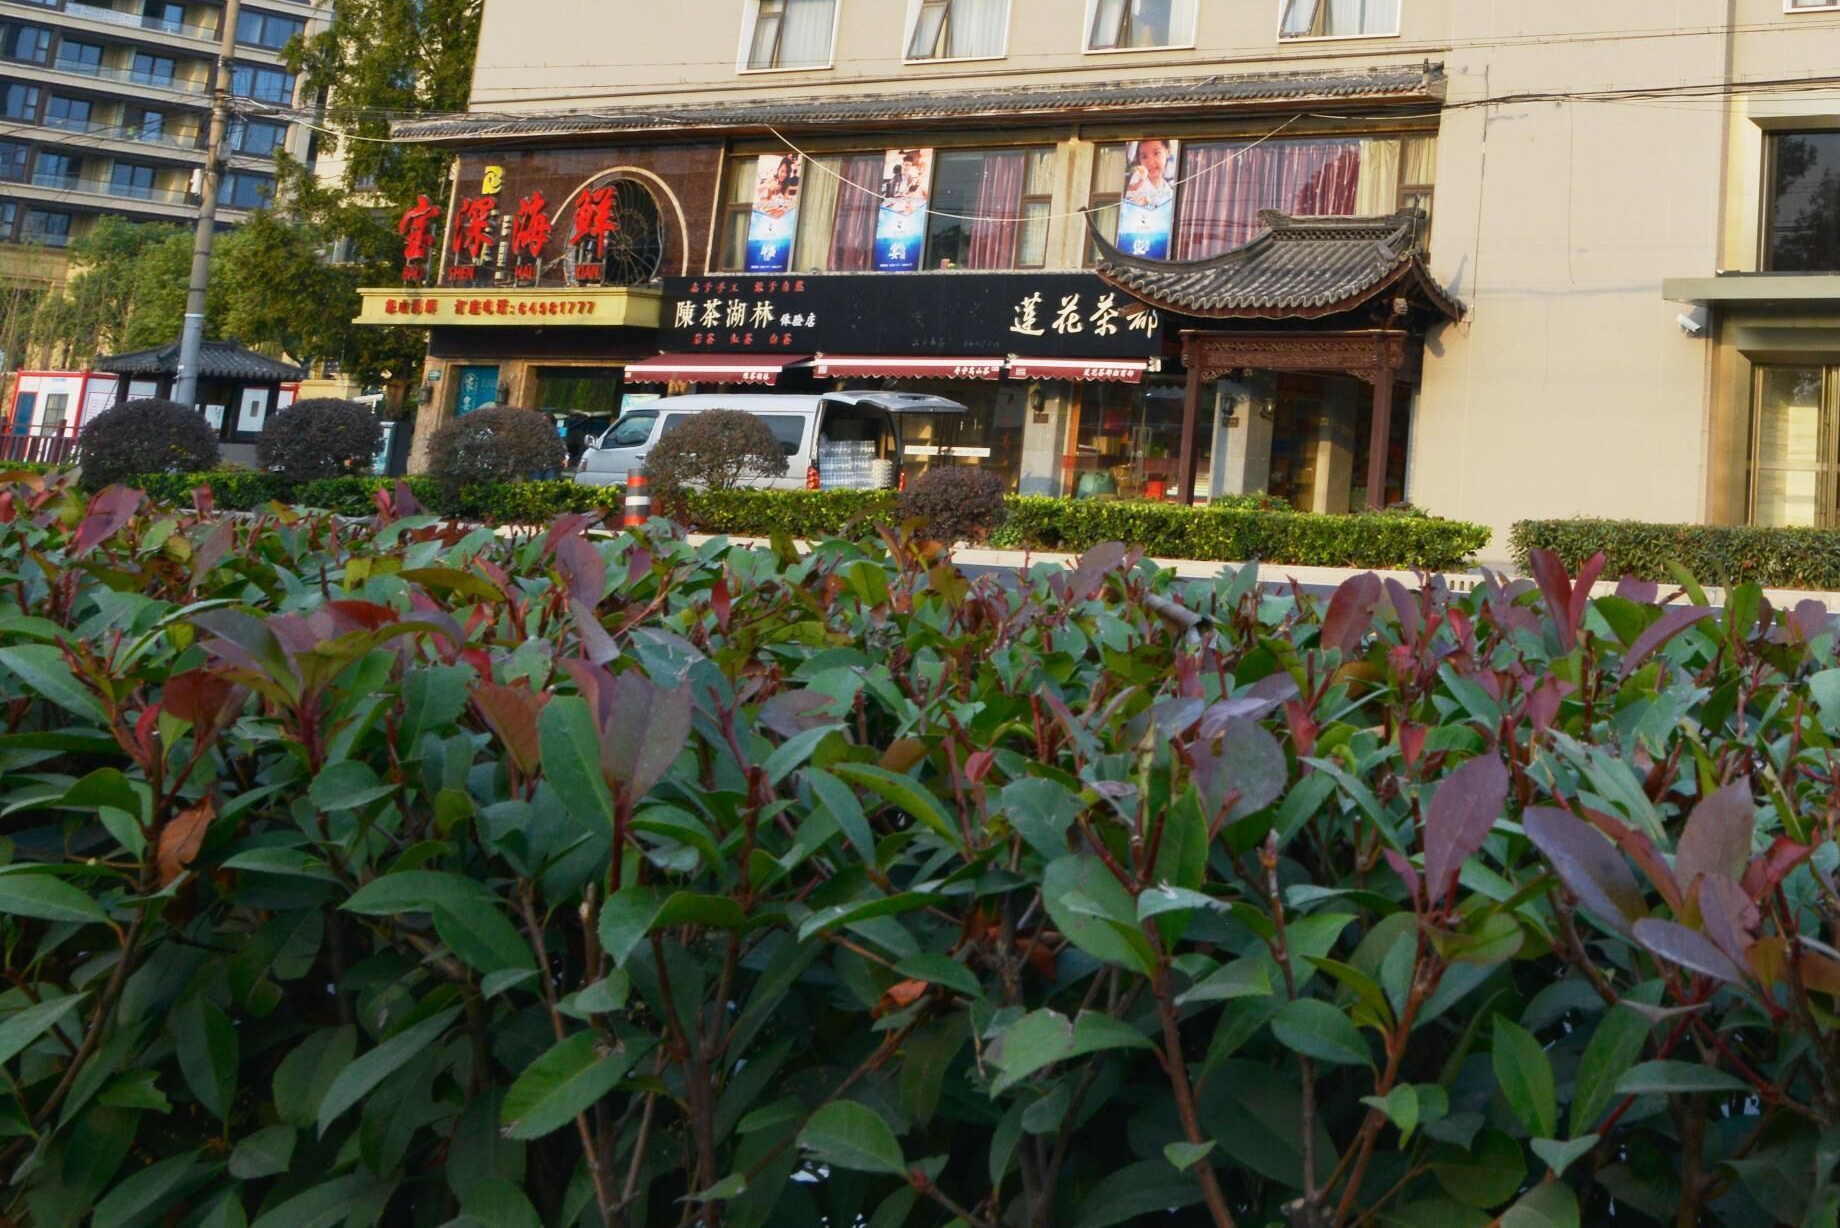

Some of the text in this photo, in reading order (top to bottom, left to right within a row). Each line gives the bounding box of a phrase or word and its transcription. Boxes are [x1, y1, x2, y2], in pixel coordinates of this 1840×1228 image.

[399, 186, 619, 260] 宝深海鲜
[779, 312, 817, 328] 体验店
